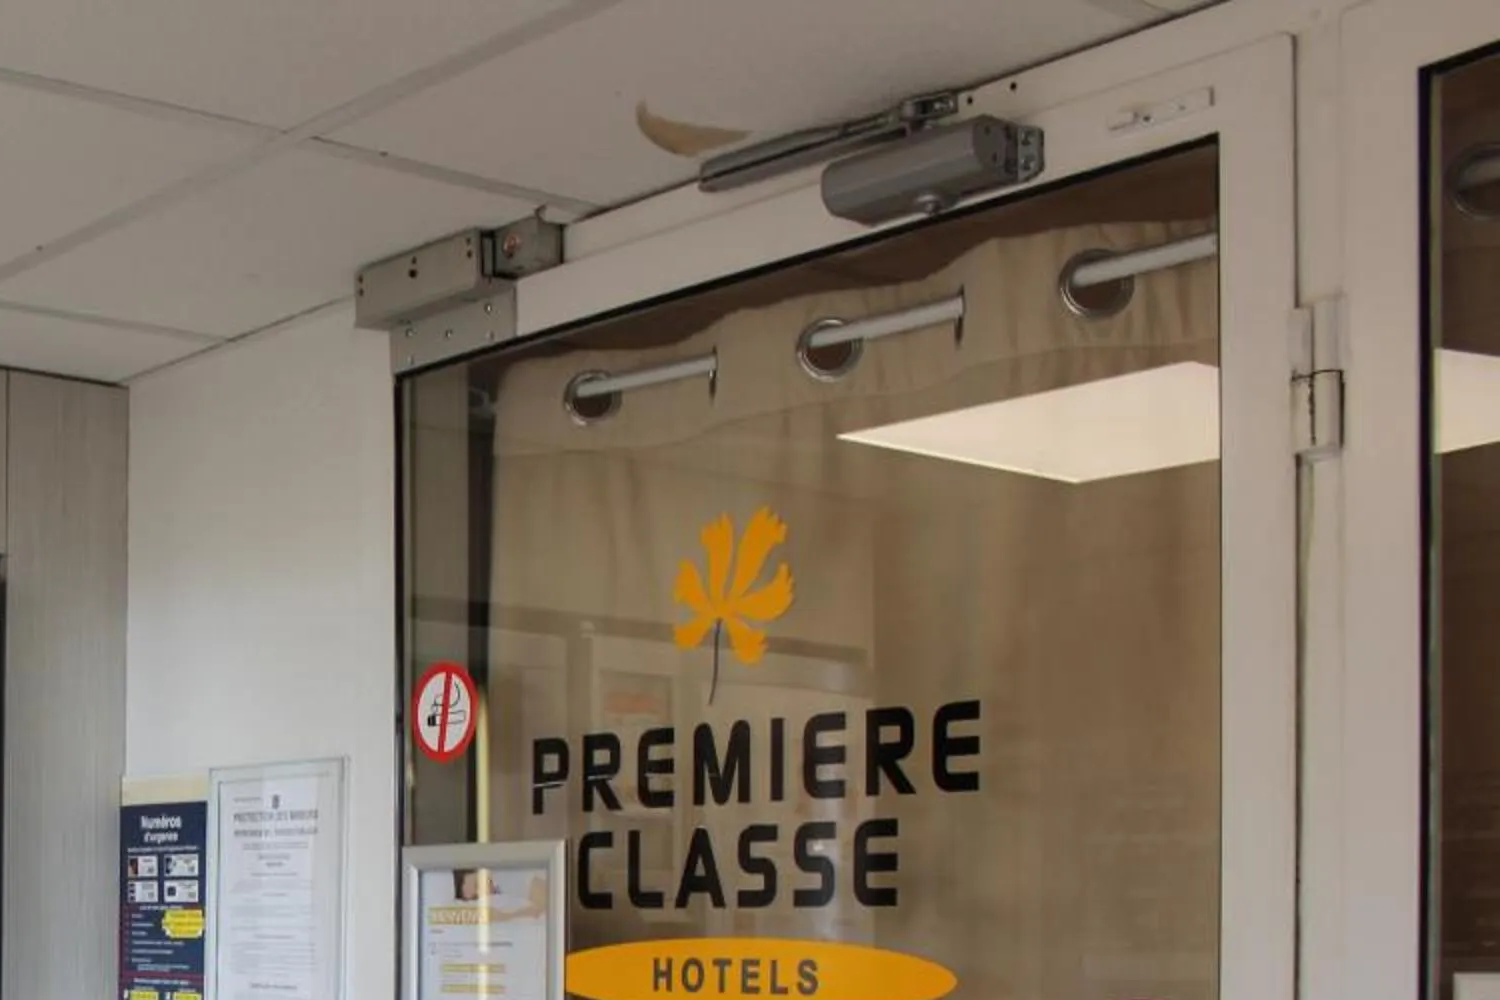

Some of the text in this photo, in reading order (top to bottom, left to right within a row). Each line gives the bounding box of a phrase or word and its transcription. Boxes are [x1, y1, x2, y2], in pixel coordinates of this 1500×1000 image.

[532, 700, 981, 815] PREMIERE
[577, 818, 899, 910] CLASSE
[651, 957, 820, 995] HOTELS
